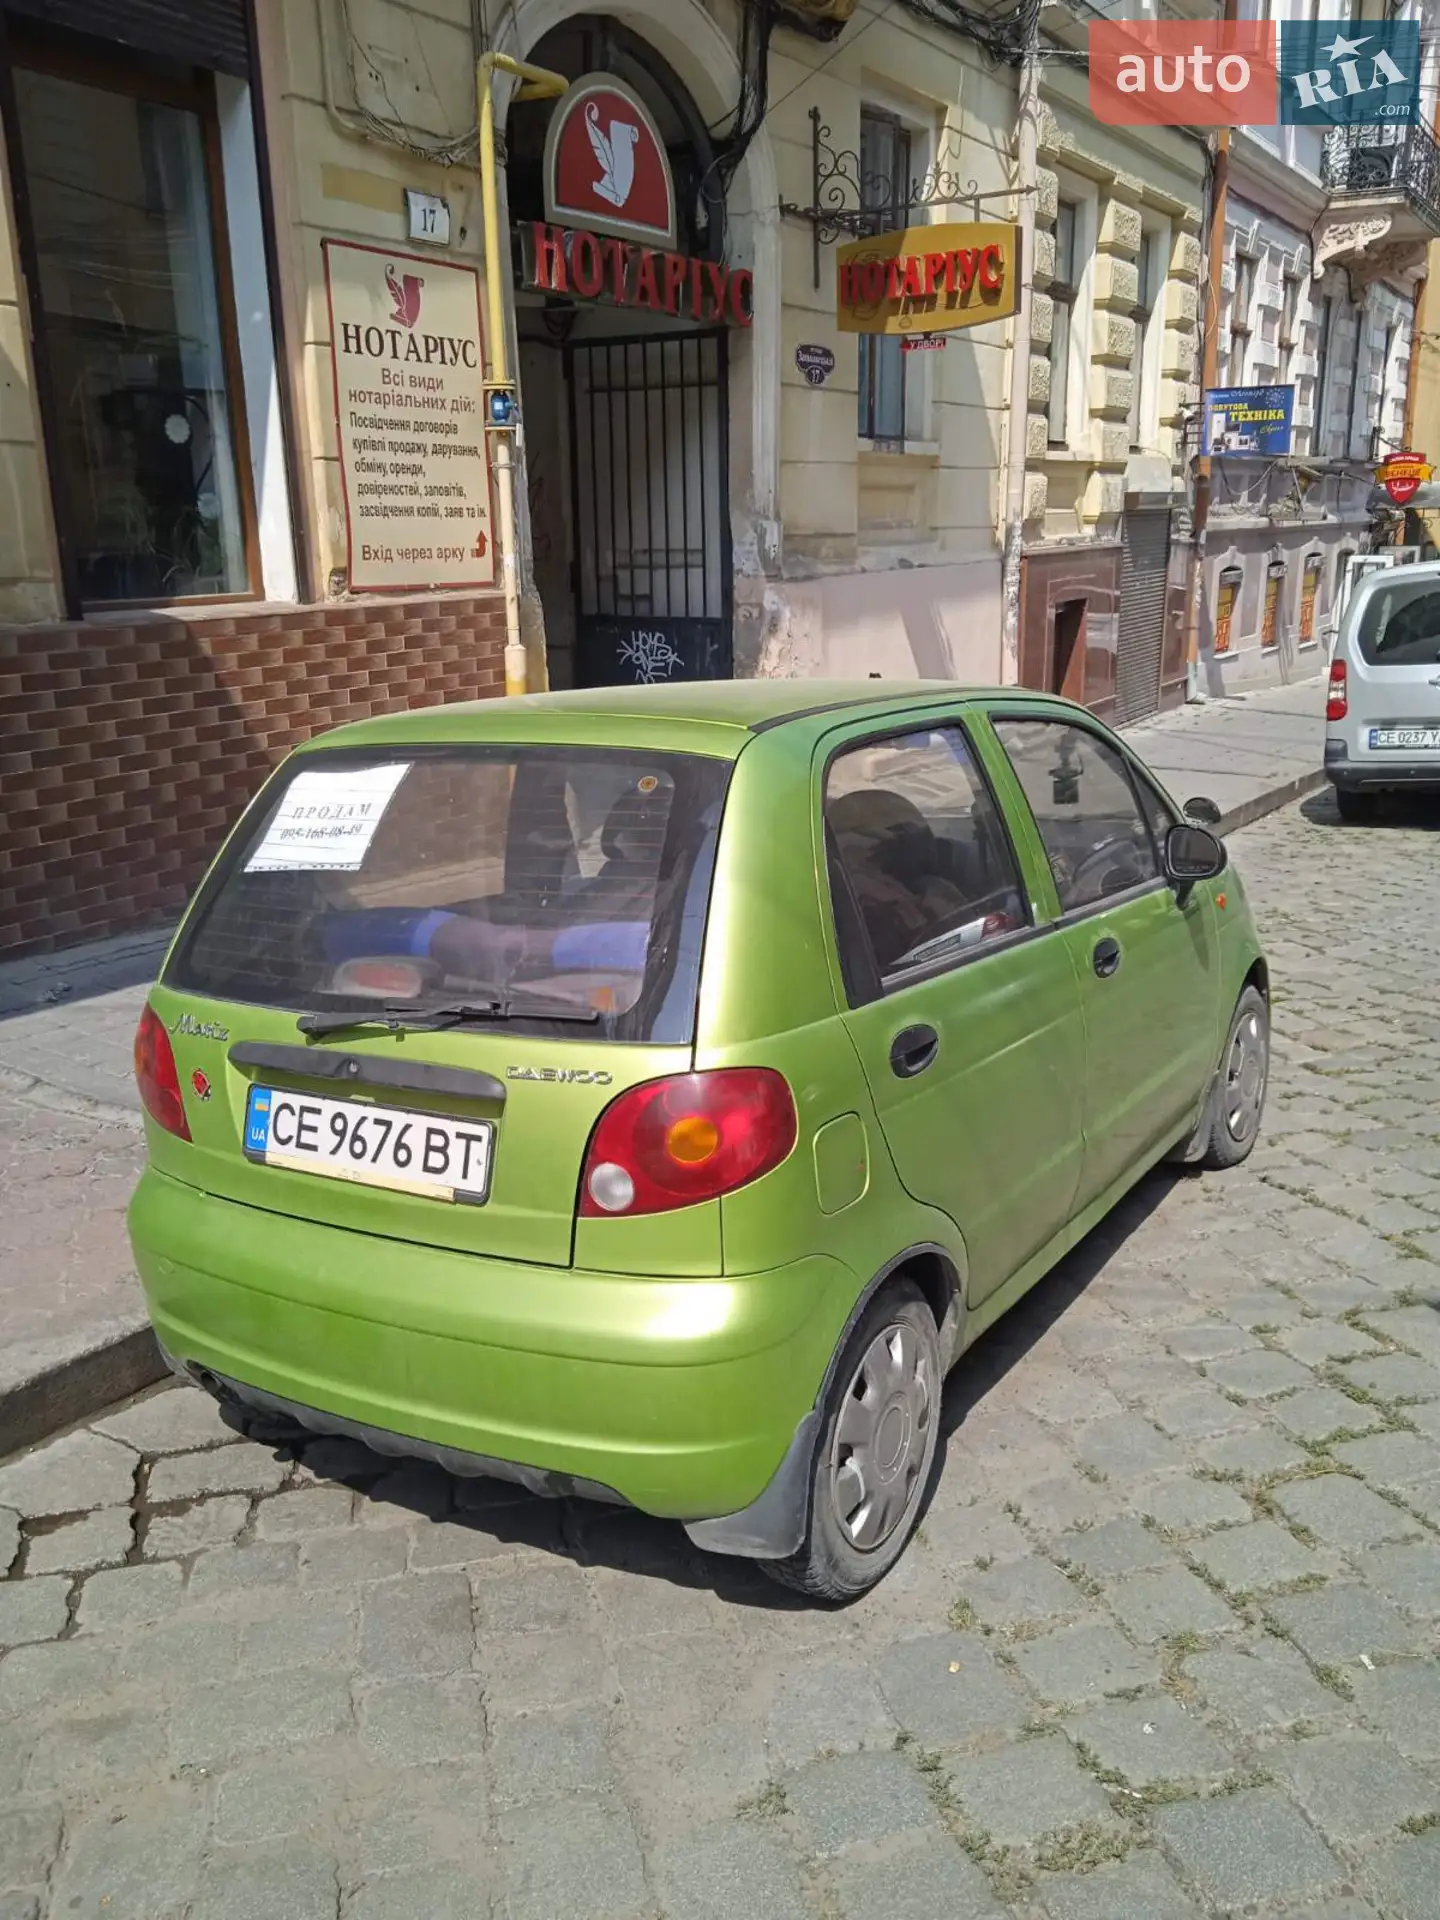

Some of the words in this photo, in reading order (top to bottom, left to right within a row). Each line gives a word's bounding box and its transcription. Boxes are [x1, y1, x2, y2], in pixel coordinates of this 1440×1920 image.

[420, 207, 437, 234] 17
[530, 220, 754, 327] НОТАРІУС
[840, 244, 1002, 309] НОТАРІУС
[341, 322, 477, 369] НОТАРІУС
[381, 367, 405, 387] Всі
[409, 375, 444, 392] види
[348, 388, 446, 410] нотаріальних
[349, 411, 412, 431] Посвідчення
[413, 419, 459, 437] договорів
[1229, 409, 1285, 422] ТЕХНІКА
[352, 435, 386, 455] купівлі
[431, 445, 481, 460] дарування,
[389, 462, 426, 477] оренди,
[357, 480, 422, 499] довіреностей,
[359, 502, 415, 519] засвідчення
[416, 503, 443, 520] копій,
[444, 505, 464, 518] заяв
[465, 506, 476, 518] та
[361, 544, 394, 563] Вхід
[396, 547, 433, 563] через
[436, 546, 466, 563] арку
[1378, 731, 1396, 744] CE
[1398, 731, 1428, 744] 0237
[291, 802, 372, 820] ПРОДАМ
[506, 1065, 613, 1086] DAEWOO
[251, 1127, 266, 1142] UA
[272, 1102, 322, 1152] CE
[328, 1111, 413, 1168] 9676
[422, 1127, 483, 1180] BT
